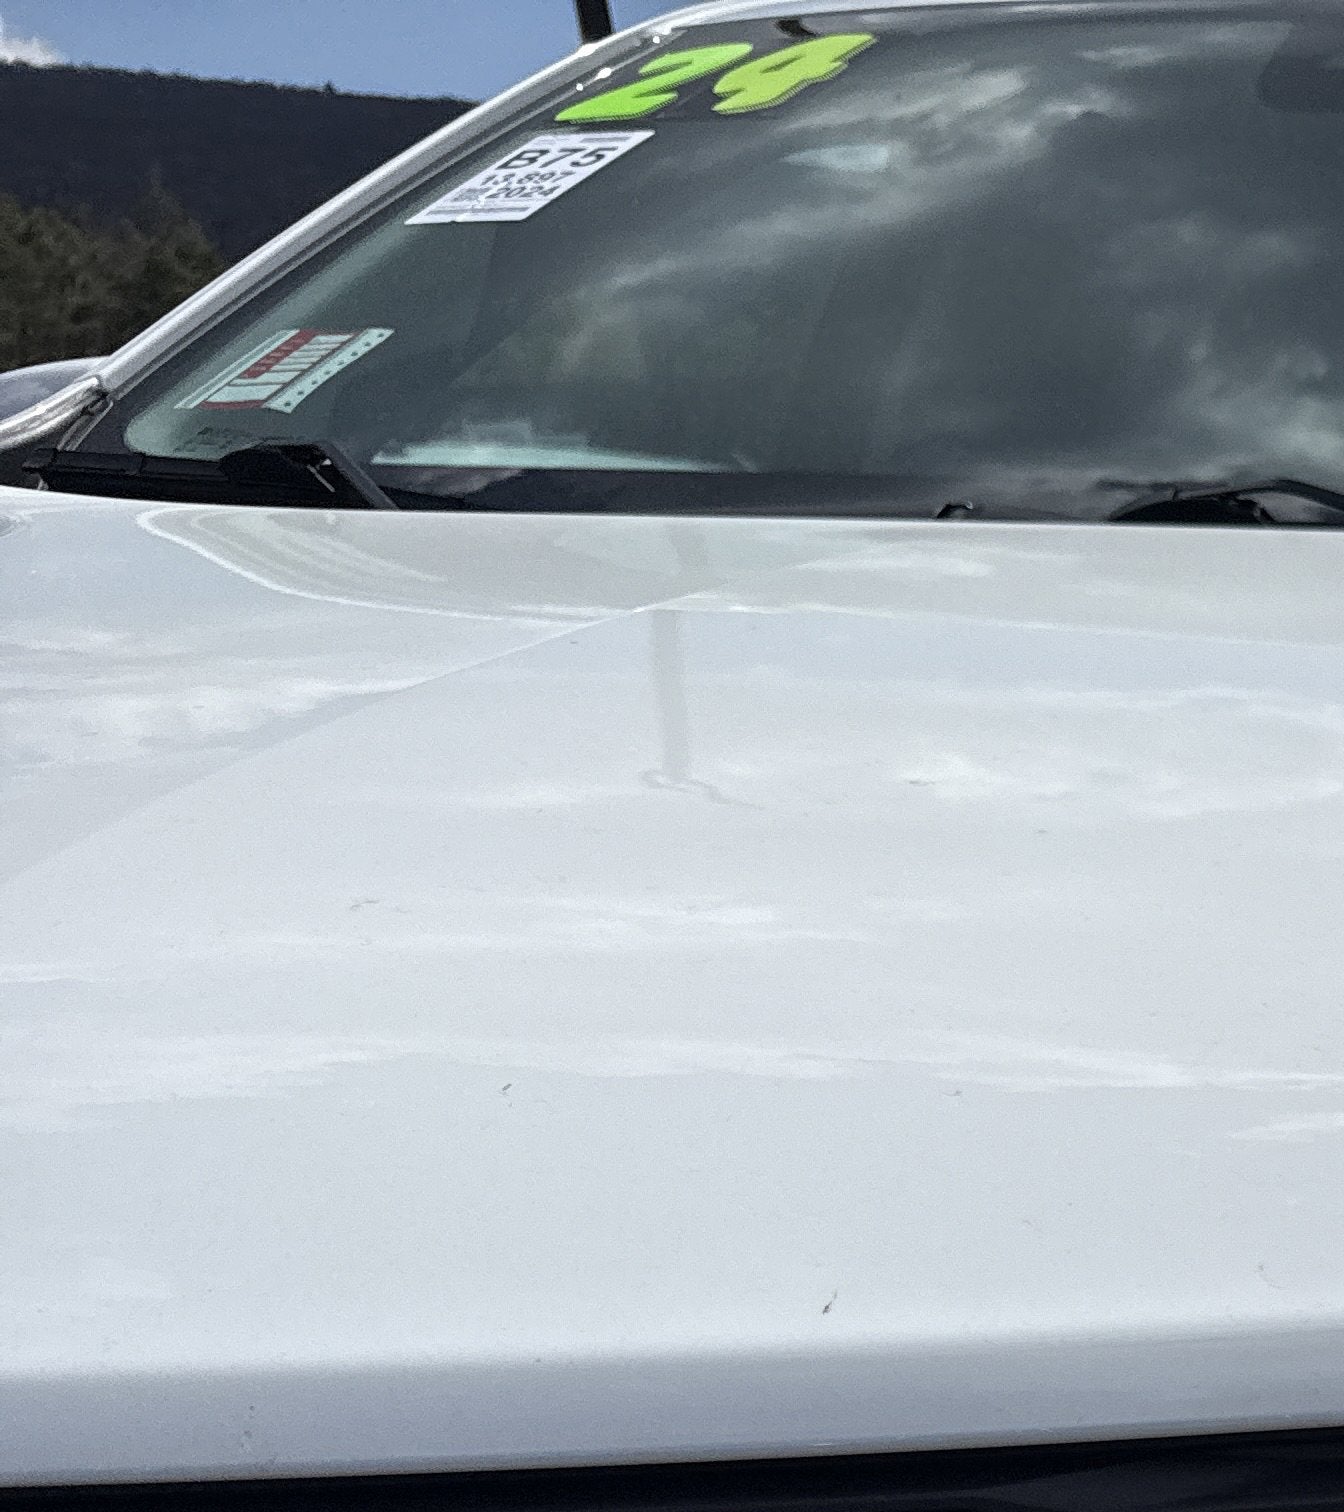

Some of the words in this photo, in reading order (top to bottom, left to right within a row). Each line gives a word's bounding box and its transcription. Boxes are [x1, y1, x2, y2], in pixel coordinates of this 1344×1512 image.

[554, 33, 878, 122] 24
[496, 146, 618, 169] B75
[486, 185, 561, 199] 2024
